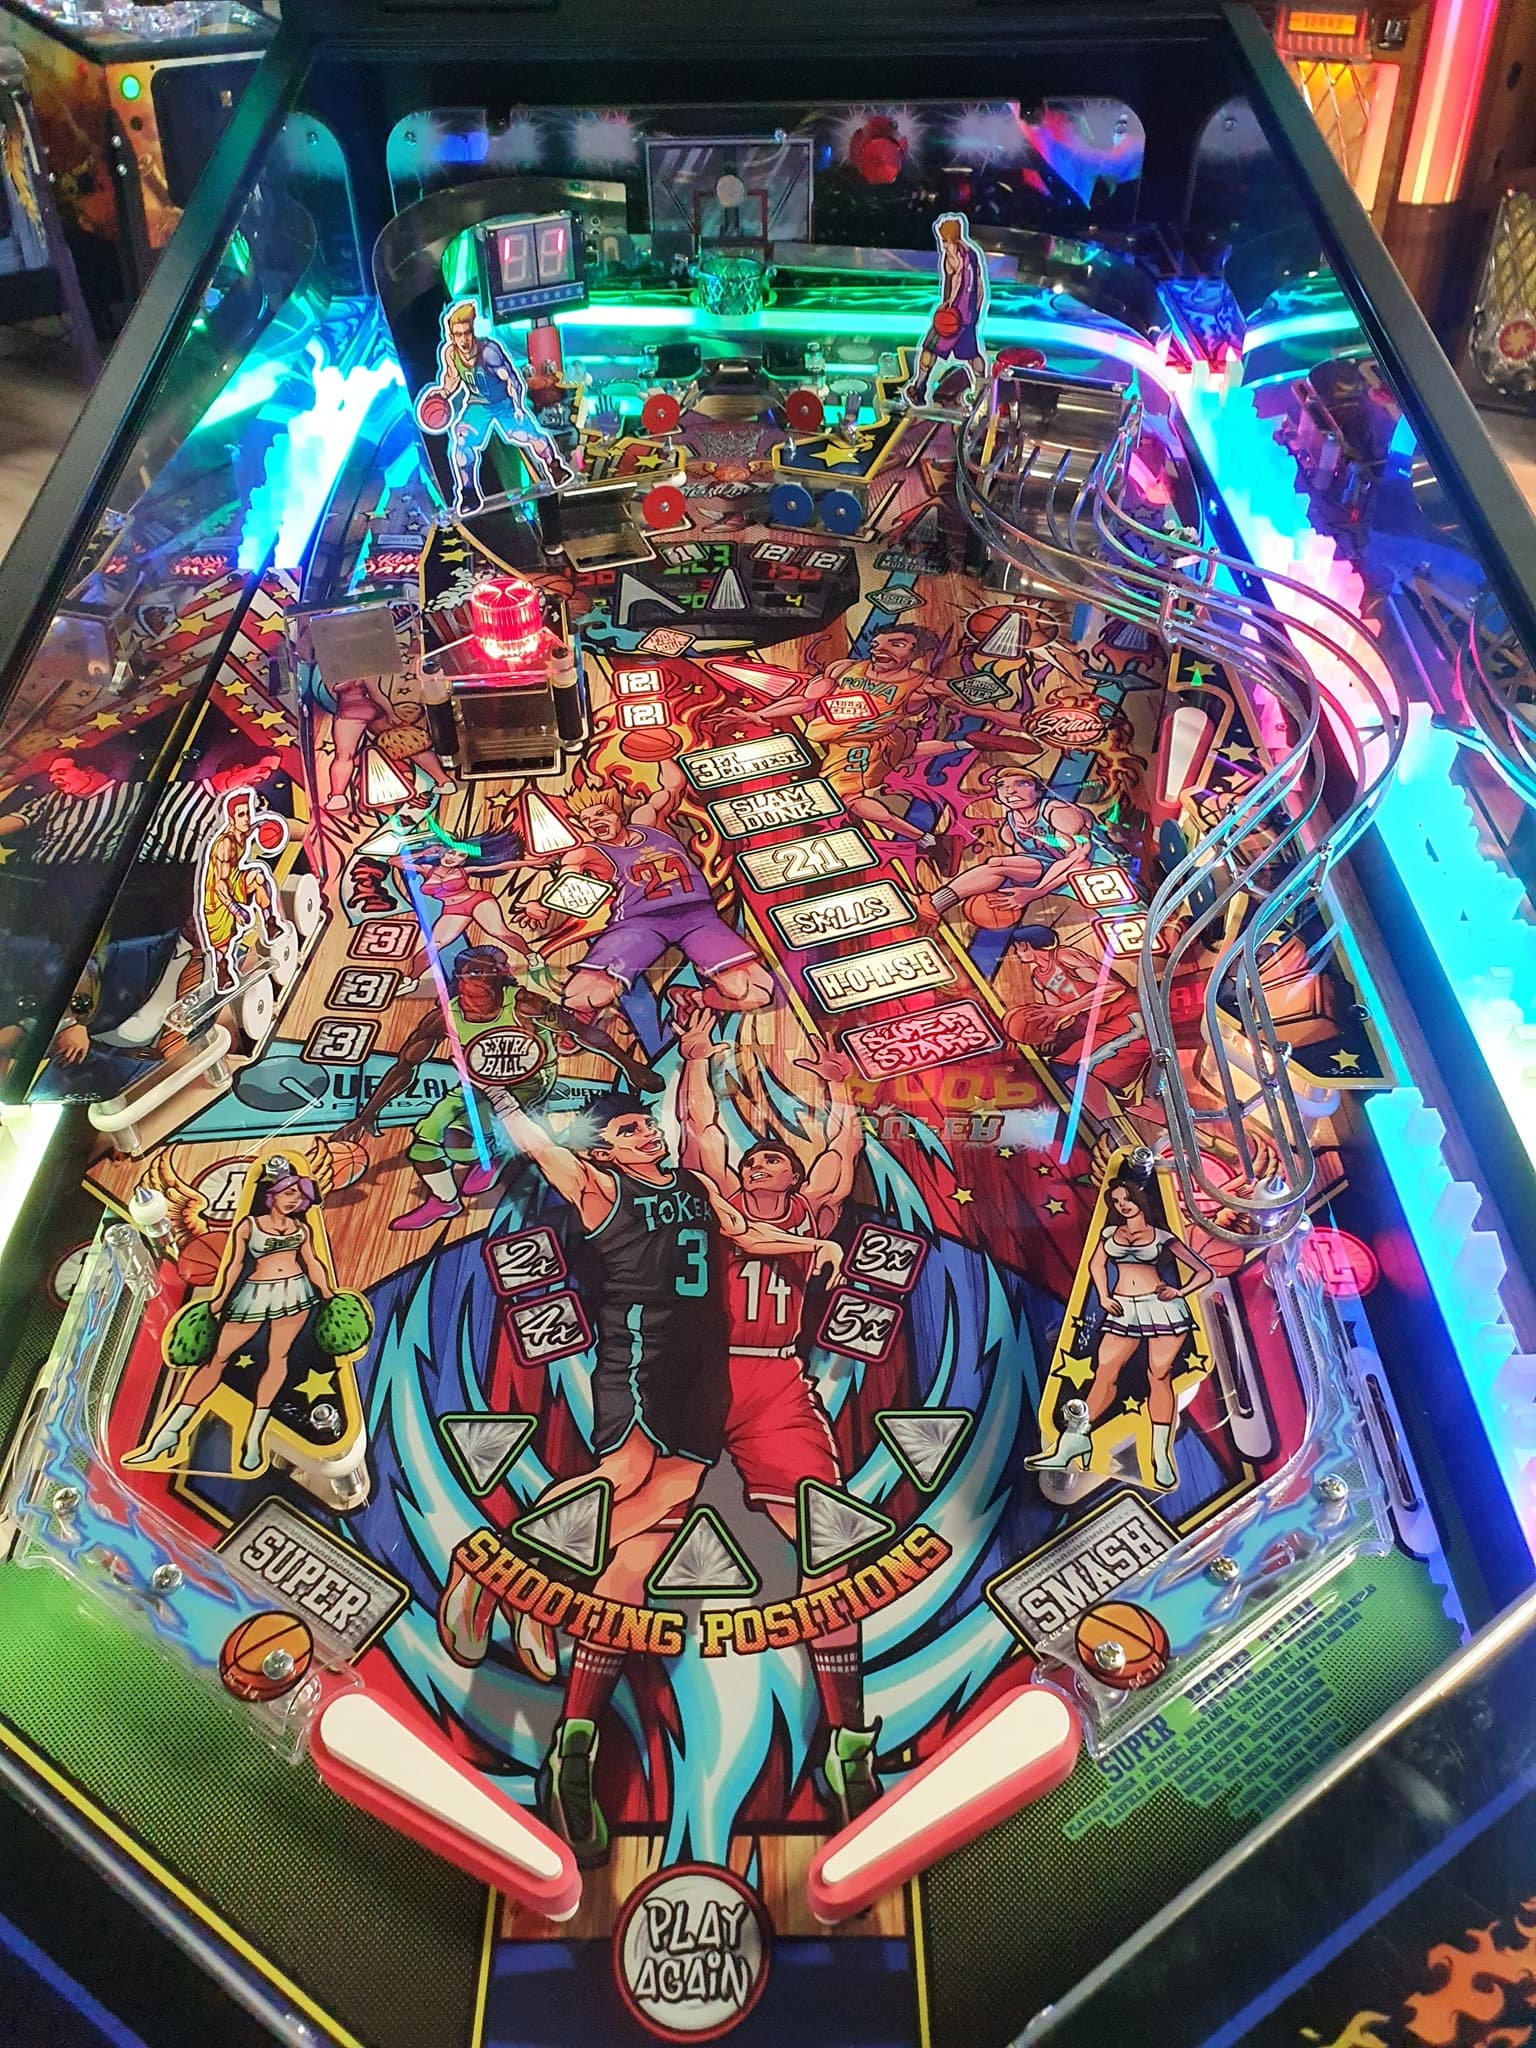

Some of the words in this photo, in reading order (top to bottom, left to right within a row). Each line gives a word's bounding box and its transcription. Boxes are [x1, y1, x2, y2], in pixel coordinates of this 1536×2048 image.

[874, 594, 917, 607] ASSIST
[962, 687, 993, 699] OVER
[963, 679, 1000, 690] CROSS
[720, 750, 803, 779] CONTEST
[846, 747, 872, 773] 9
[731, 786, 811, 815] SLAM
[739, 802, 822, 832] DUNK
[774, 839, 847, 882] 21
[480, 1038, 533, 1057] EXTRA
[861, 1010, 973, 1051] SUPER
[870, 1026, 989, 1070] STARS
[478, 1056, 528, 1078] BALL
[675, 1228, 710, 1297] 3
[738, 1259, 793, 1326] 14
[240, 1525, 372, 1634] SUPER
[455, 1526, 686, 1658] SHOOTING
[699, 1523, 954, 1659] POSITIONS
[1018, 1515, 1169, 1635] SMASH
[1066, 1798, 1109, 1835] PLAYFIELD
[1140, 1740, 1180, 1775] SOFTWARE
[1206, 1705, 1224, 1721] AND
[1221, 1693, 1238, 1709] ALL
[1236, 1681, 1253, 1697] THE
[1097, 1714, 1177, 1784] SUPER
[1144, 1773, 1162, 1790] AND
[643, 1895, 750, 1956] PLAY
